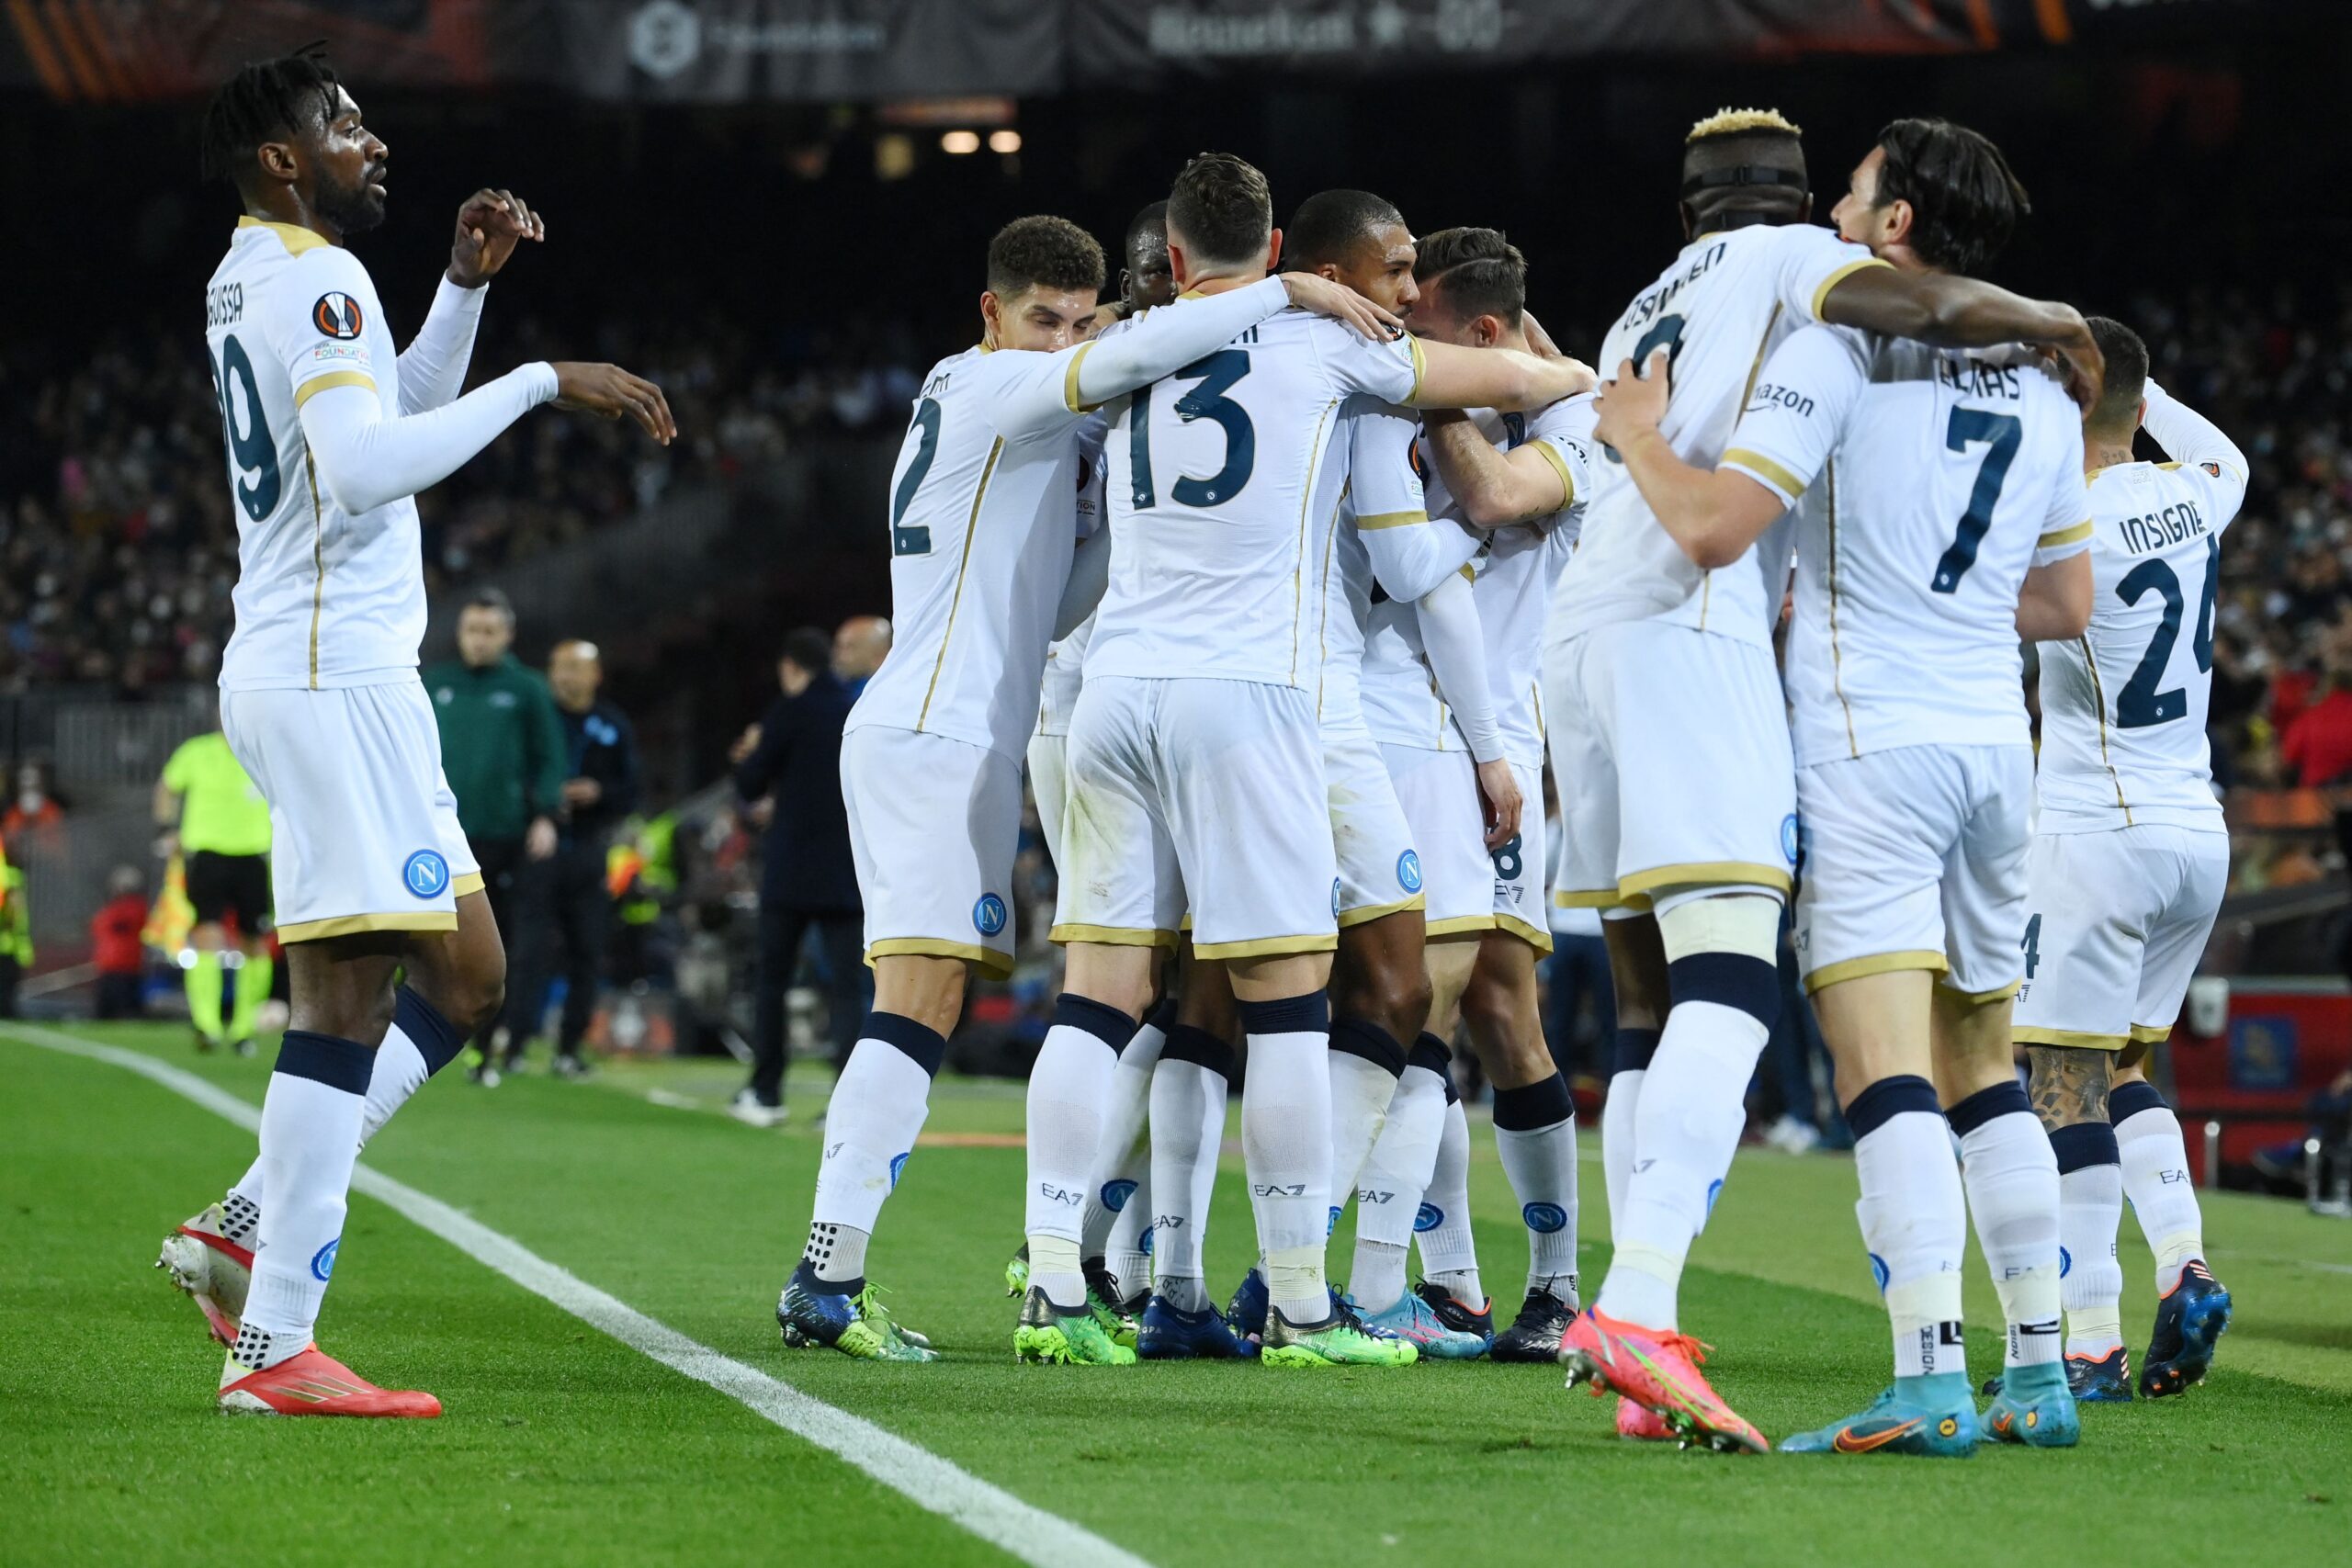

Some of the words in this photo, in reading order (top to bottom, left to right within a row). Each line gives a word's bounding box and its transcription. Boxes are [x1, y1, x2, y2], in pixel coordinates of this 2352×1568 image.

[1130, 349, 1255, 510] 13
[1931, 404, 2022, 593] 7
[1042, 1182, 1084, 1206] EA7
[1254, 1184, 1306, 1197] EA7
[1359, 1190, 1395, 1204] EA7
